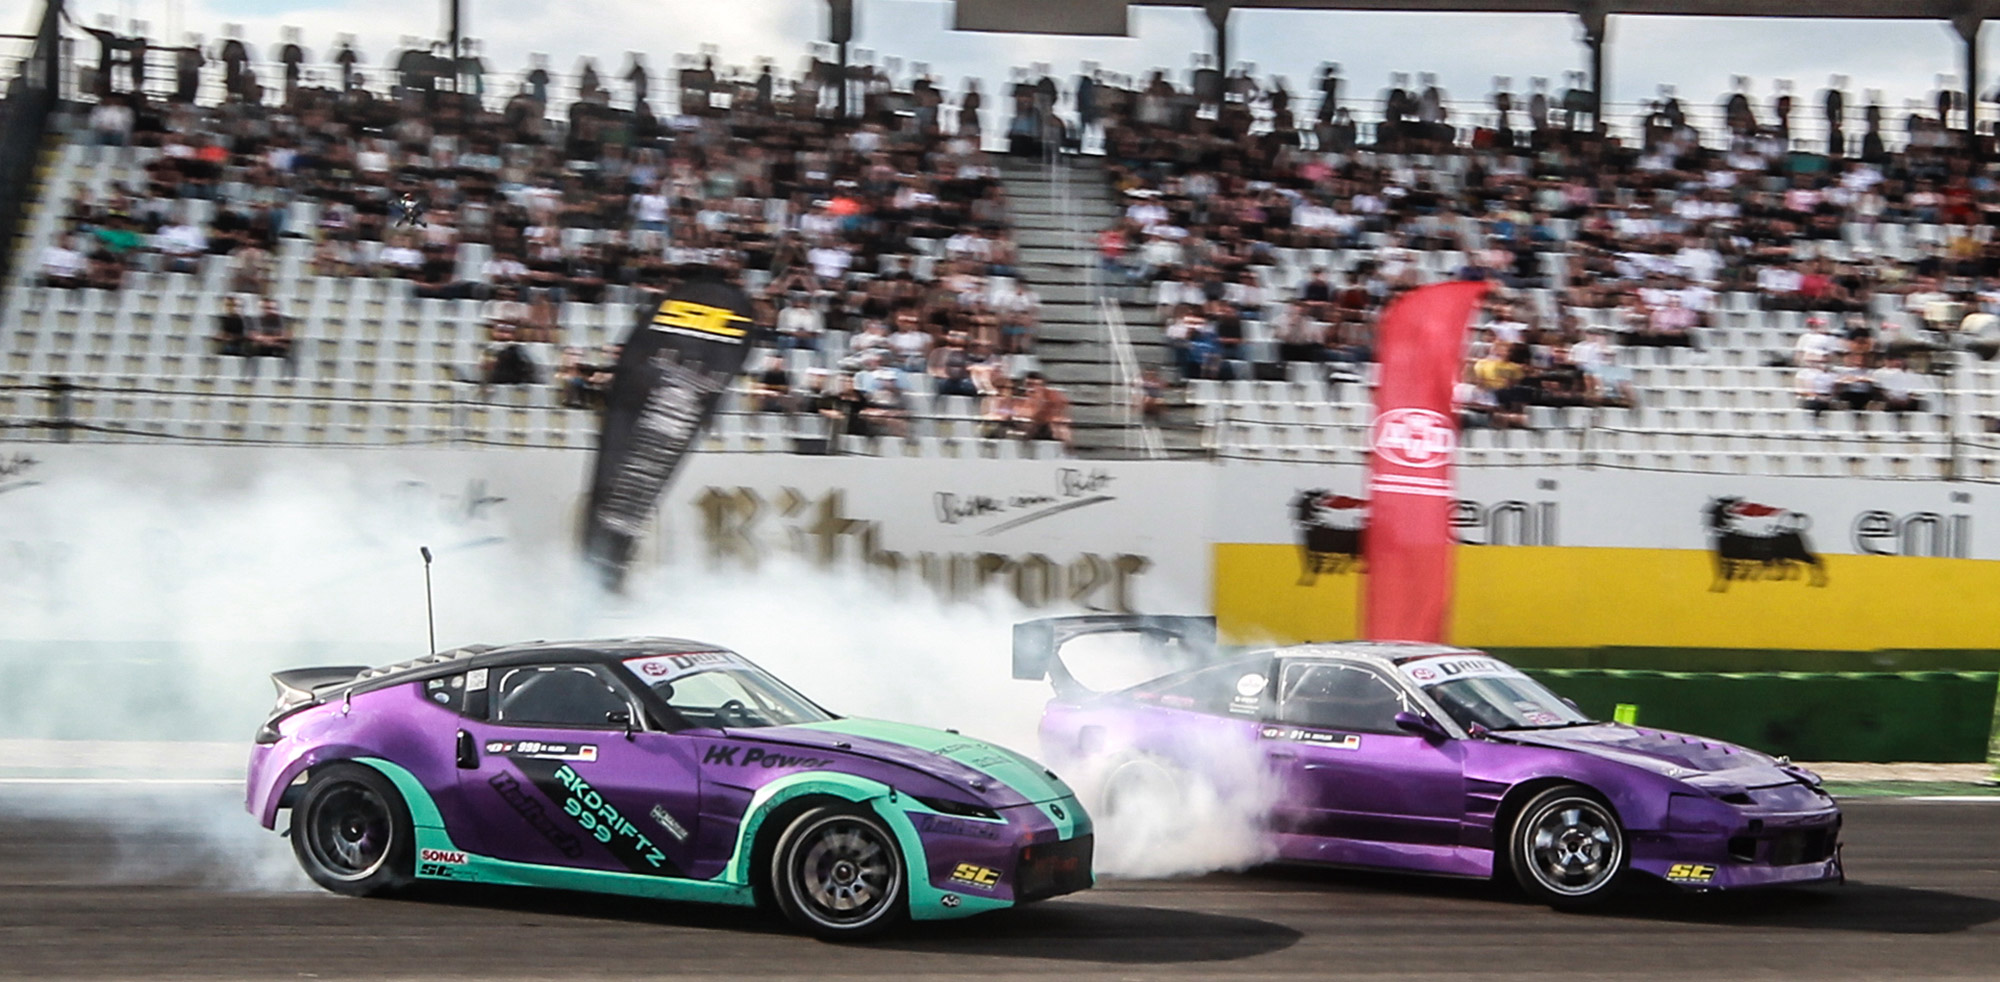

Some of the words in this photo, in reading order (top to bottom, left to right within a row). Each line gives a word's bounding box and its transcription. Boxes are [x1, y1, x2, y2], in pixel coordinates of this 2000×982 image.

[1851, 491, 1972, 558] eni
[517, 741, 541, 753] 999
[702, 745, 741, 767] HK
[740, 747, 836, 769] Power
[554, 764, 667, 868] RKDRIFTZ
[563, 797, 612, 843] 999
[422, 849, 466, 864] SONAX
